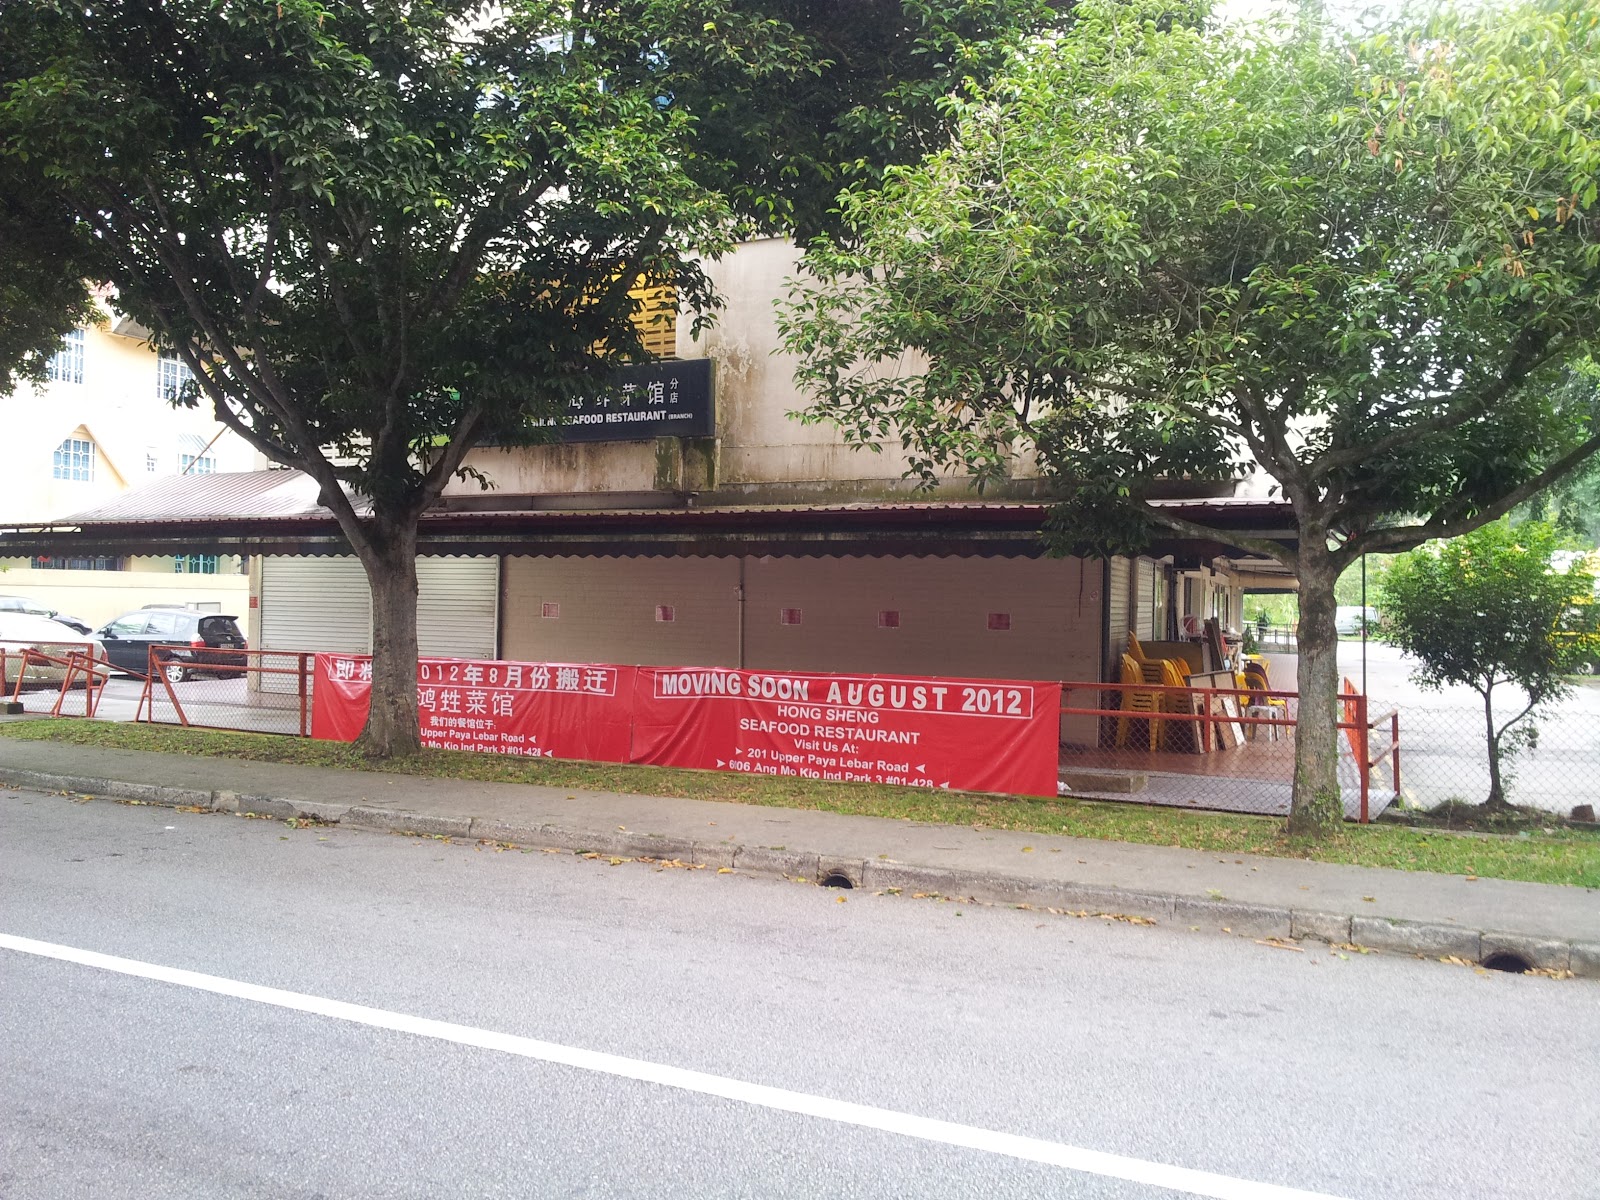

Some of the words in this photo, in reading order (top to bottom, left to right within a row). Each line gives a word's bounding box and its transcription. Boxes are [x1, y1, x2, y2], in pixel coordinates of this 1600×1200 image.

[669, 377, 679, 404] 分店
[605, 410, 667, 423] RESTAURANT
[662, 672, 741, 695] MOVING
[747, 675, 809, 701] SOON
[826, 681, 948, 711] AUGUST
[961, 687, 1022, 715] 2012
[777, 705, 822, 720] HONG
[825, 708, 879, 724] SHENG
[420, 727, 447, 739] Upper
[449, 730, 471, 741] Paya
[473, 731, 499, 742] Lebar
[500, 733, 525, 743] Road
[739, 718, 810, 736] SEAFOOD
[814, 725, 921, 745] RESTAURANT
[428, 740, 441, 749] Mo
[444, 741, 459, 750] Kio
[461, 743, 475, 752] Ind
[477, 745, 498, 754] Park
[500, 745, 506, 754] 3
[794, 738, 820, 751] Visit
[822, 741, 839, 752] Us
[841, 743, 859, 754] At:
[728, 759, 751, 772] 606
[754, 762, 777, 776] Ang
[780, 765, 797, 776] Mo
[799, 767, 820, 779] Kio
[823, 770, 841, 780] Ind
[845, 772, 871, 783] Park
[747, 748, 767, 759] 201
[771, 750, 805, 763] Upper
[808, 754, 836, 767] Paya
[840, 757, 874, 770] Lebar
[877, 760, 909, 773] Road
